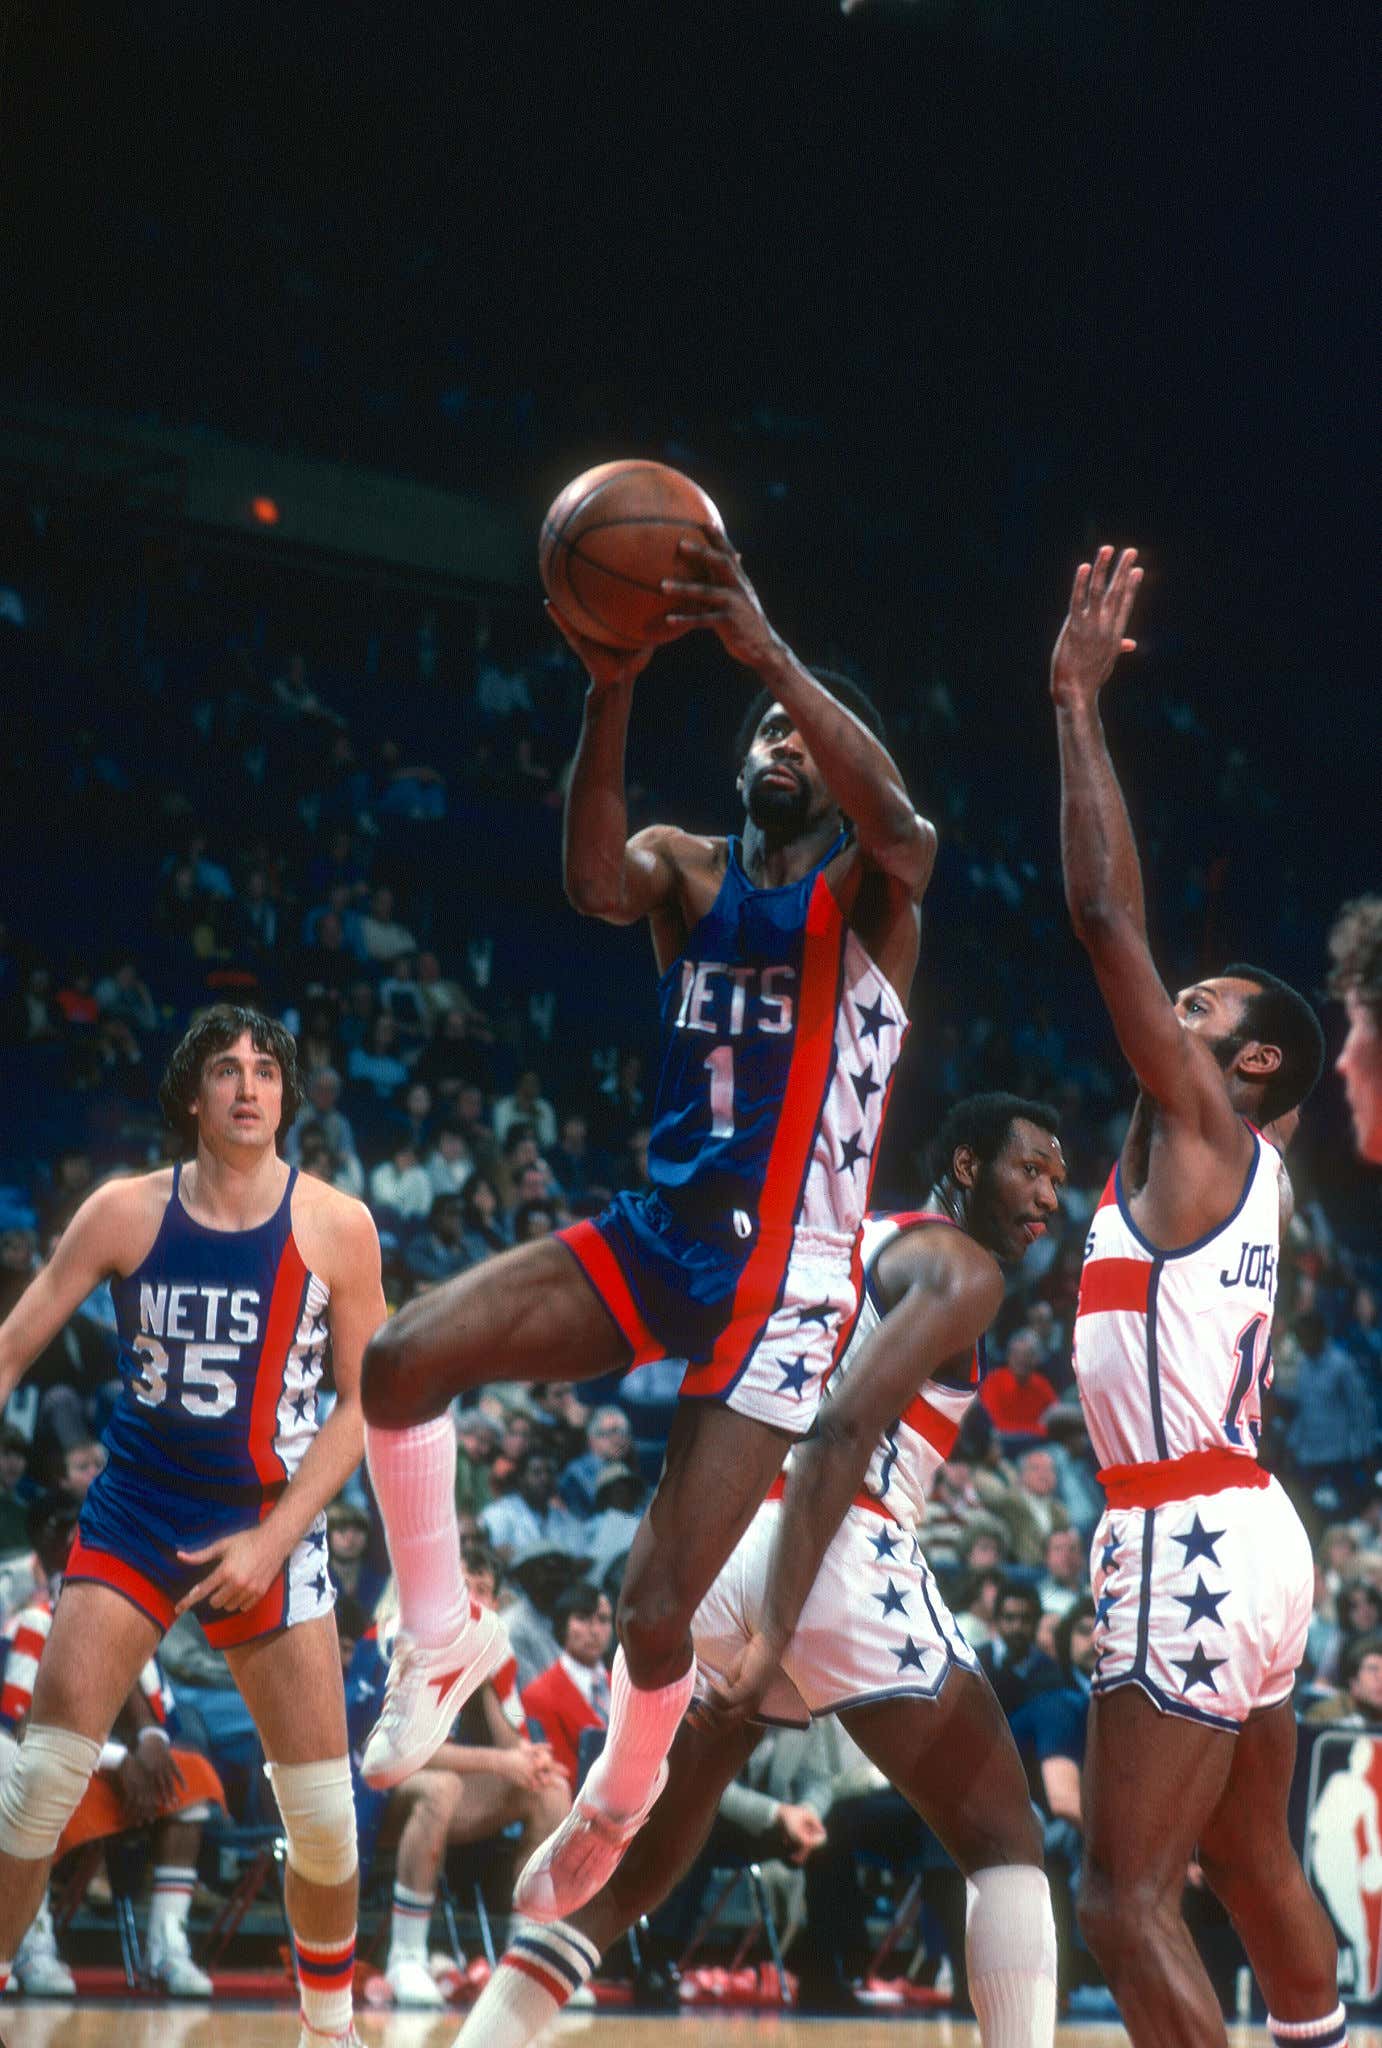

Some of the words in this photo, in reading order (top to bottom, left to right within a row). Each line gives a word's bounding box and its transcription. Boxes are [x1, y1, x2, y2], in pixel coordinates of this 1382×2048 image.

[704, 1045, 735, 1139] 1
[139, 1282, 260, 1344] NETS
[132, 1333, 241, 1418] 35
